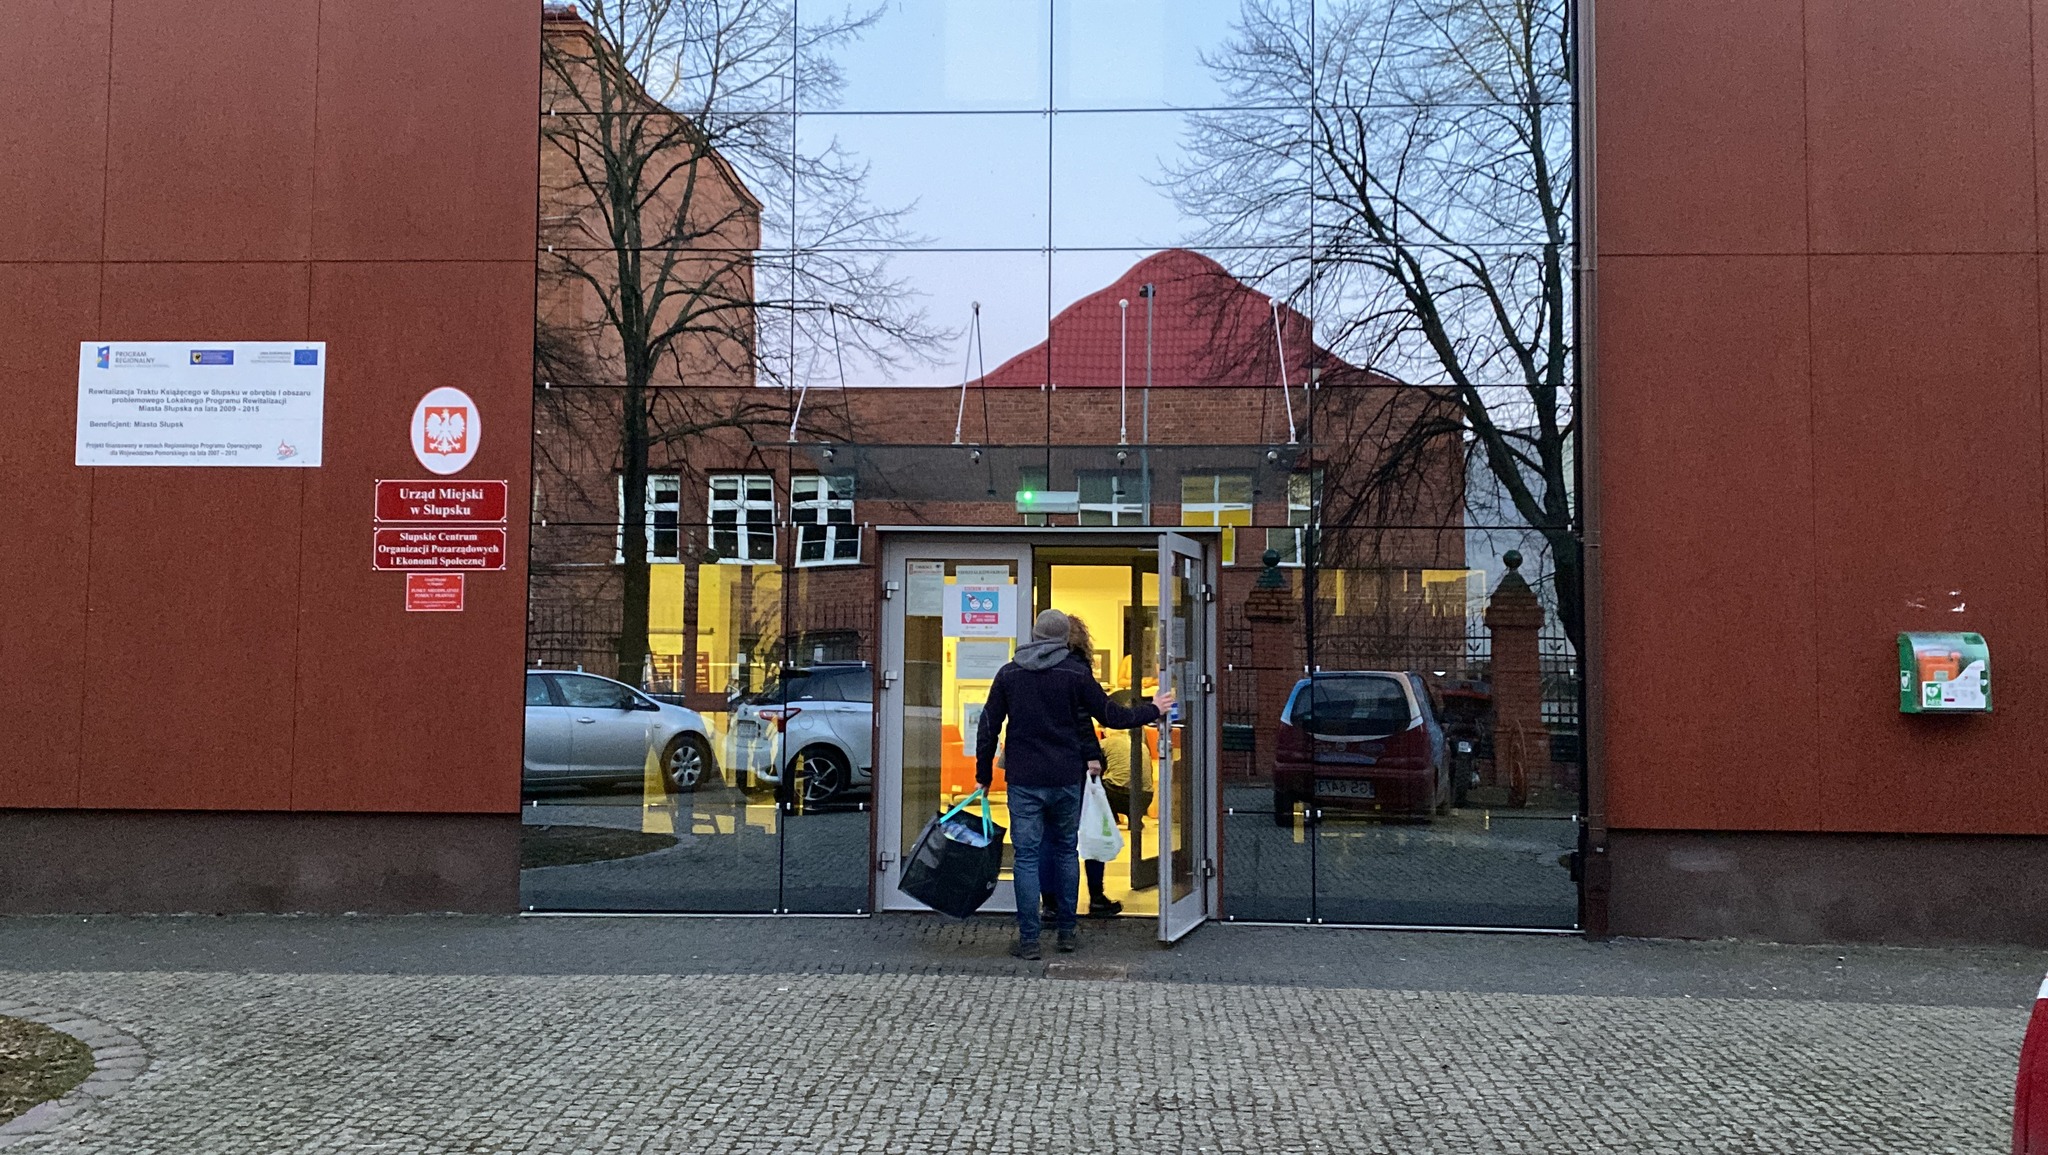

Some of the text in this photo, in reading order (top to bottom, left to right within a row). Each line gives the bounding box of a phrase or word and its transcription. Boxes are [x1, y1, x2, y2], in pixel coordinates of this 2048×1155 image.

[88, 388, 134, 396] Rewitalizacja
[160, 388, 201, 396] Książęcego
[211, 389, 240, 397] Słupsku
[250, 389, 276, 397] obrębie
[242, 398, 287, 406] Rewitalizacji
[400, 488, 484, 502] Urząd Miejski
[410, 504, 471, 518] w Słupsku
[400, 532, 436, 542] Słupskie
[378, 545, 499, 555] Organizacji Pozarządowych
[390, 557, 486, 567] i Ekonomii Społecznej
